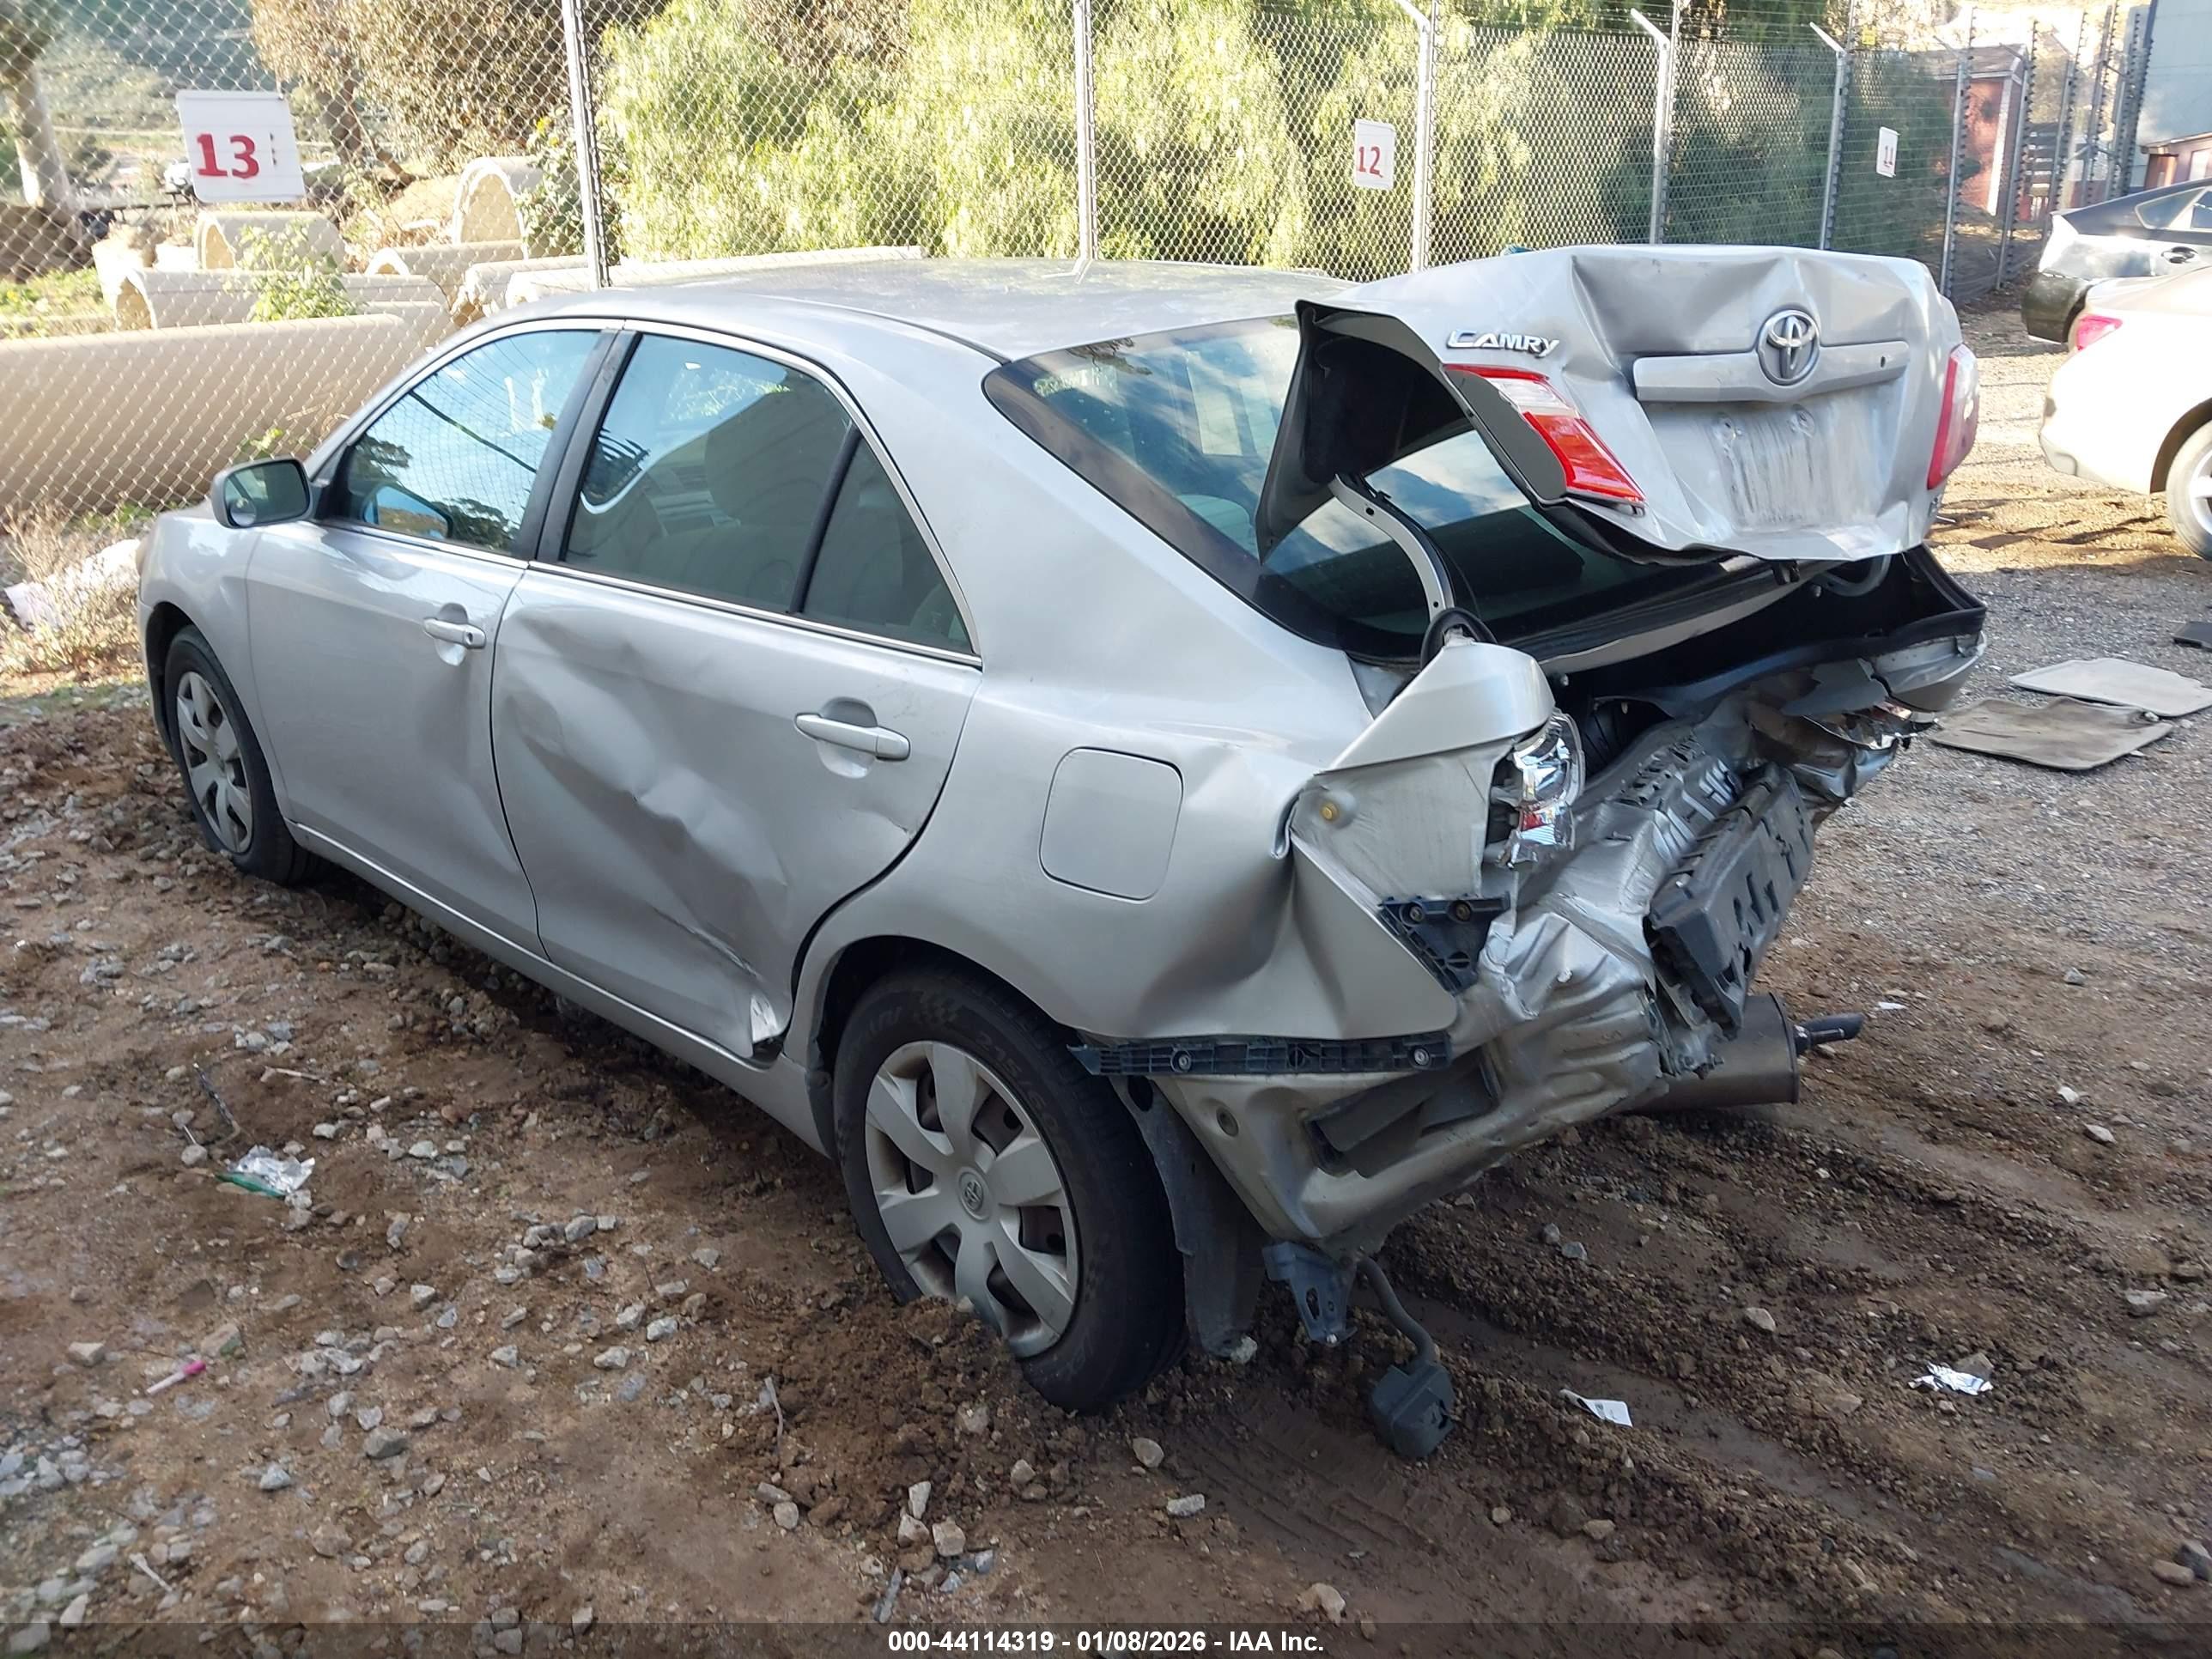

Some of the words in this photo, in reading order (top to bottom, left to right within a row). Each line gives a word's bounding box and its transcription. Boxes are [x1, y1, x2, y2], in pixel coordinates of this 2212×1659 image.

[197, 133, 259, 179] 13
[1358, 146, 1382, 177] 12
[1446, 329, 1560, 358] CAMRY
